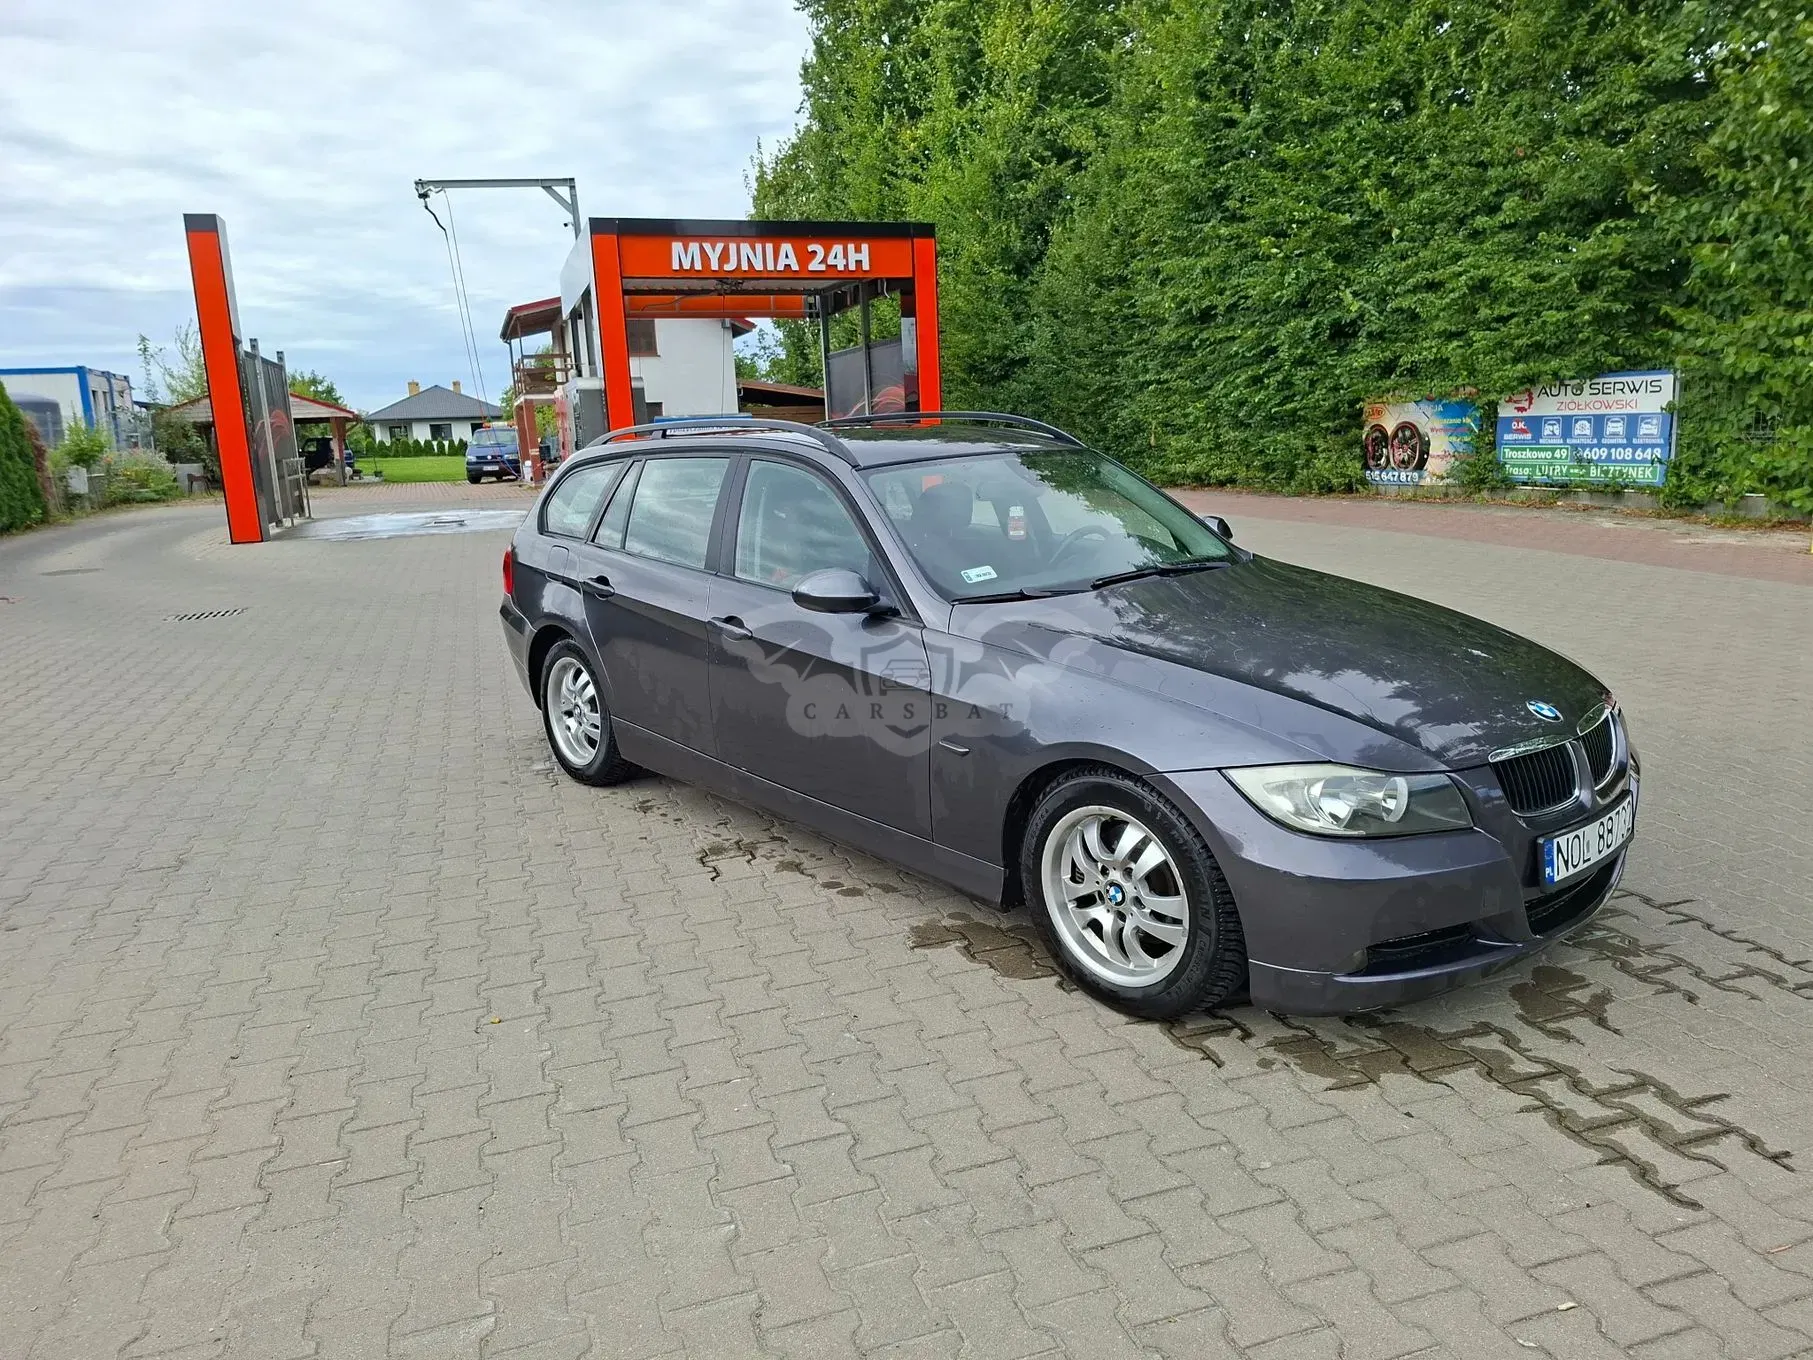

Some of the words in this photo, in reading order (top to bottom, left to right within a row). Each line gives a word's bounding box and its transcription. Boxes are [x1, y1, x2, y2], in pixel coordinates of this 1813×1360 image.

[671, 242, 799, 271] MYJNIA
[806, 243, 870, 271] 24H
[1537, 382, 1584, 398] AUTO
[1589, 379, 1662, 396] SERWIS
[1504, 448, 1552, 459] Troszkowo
[1553, 448, 1568, 459] 49
[1583, 447, 1608, 460] 609
[1610, 447, 1632, 460] 108
[1635, 447, 1662, 461] 648
[1365, 470, 1380, 481] 515
[1381, 471, 1399, 482] 647
[1400, 471, 1419, 482] 879
[1536, 465, 1568, 476] LUTRY
[1556, 830, 1592, 877] NOL
[1545, 866, 1554, 879] PL
